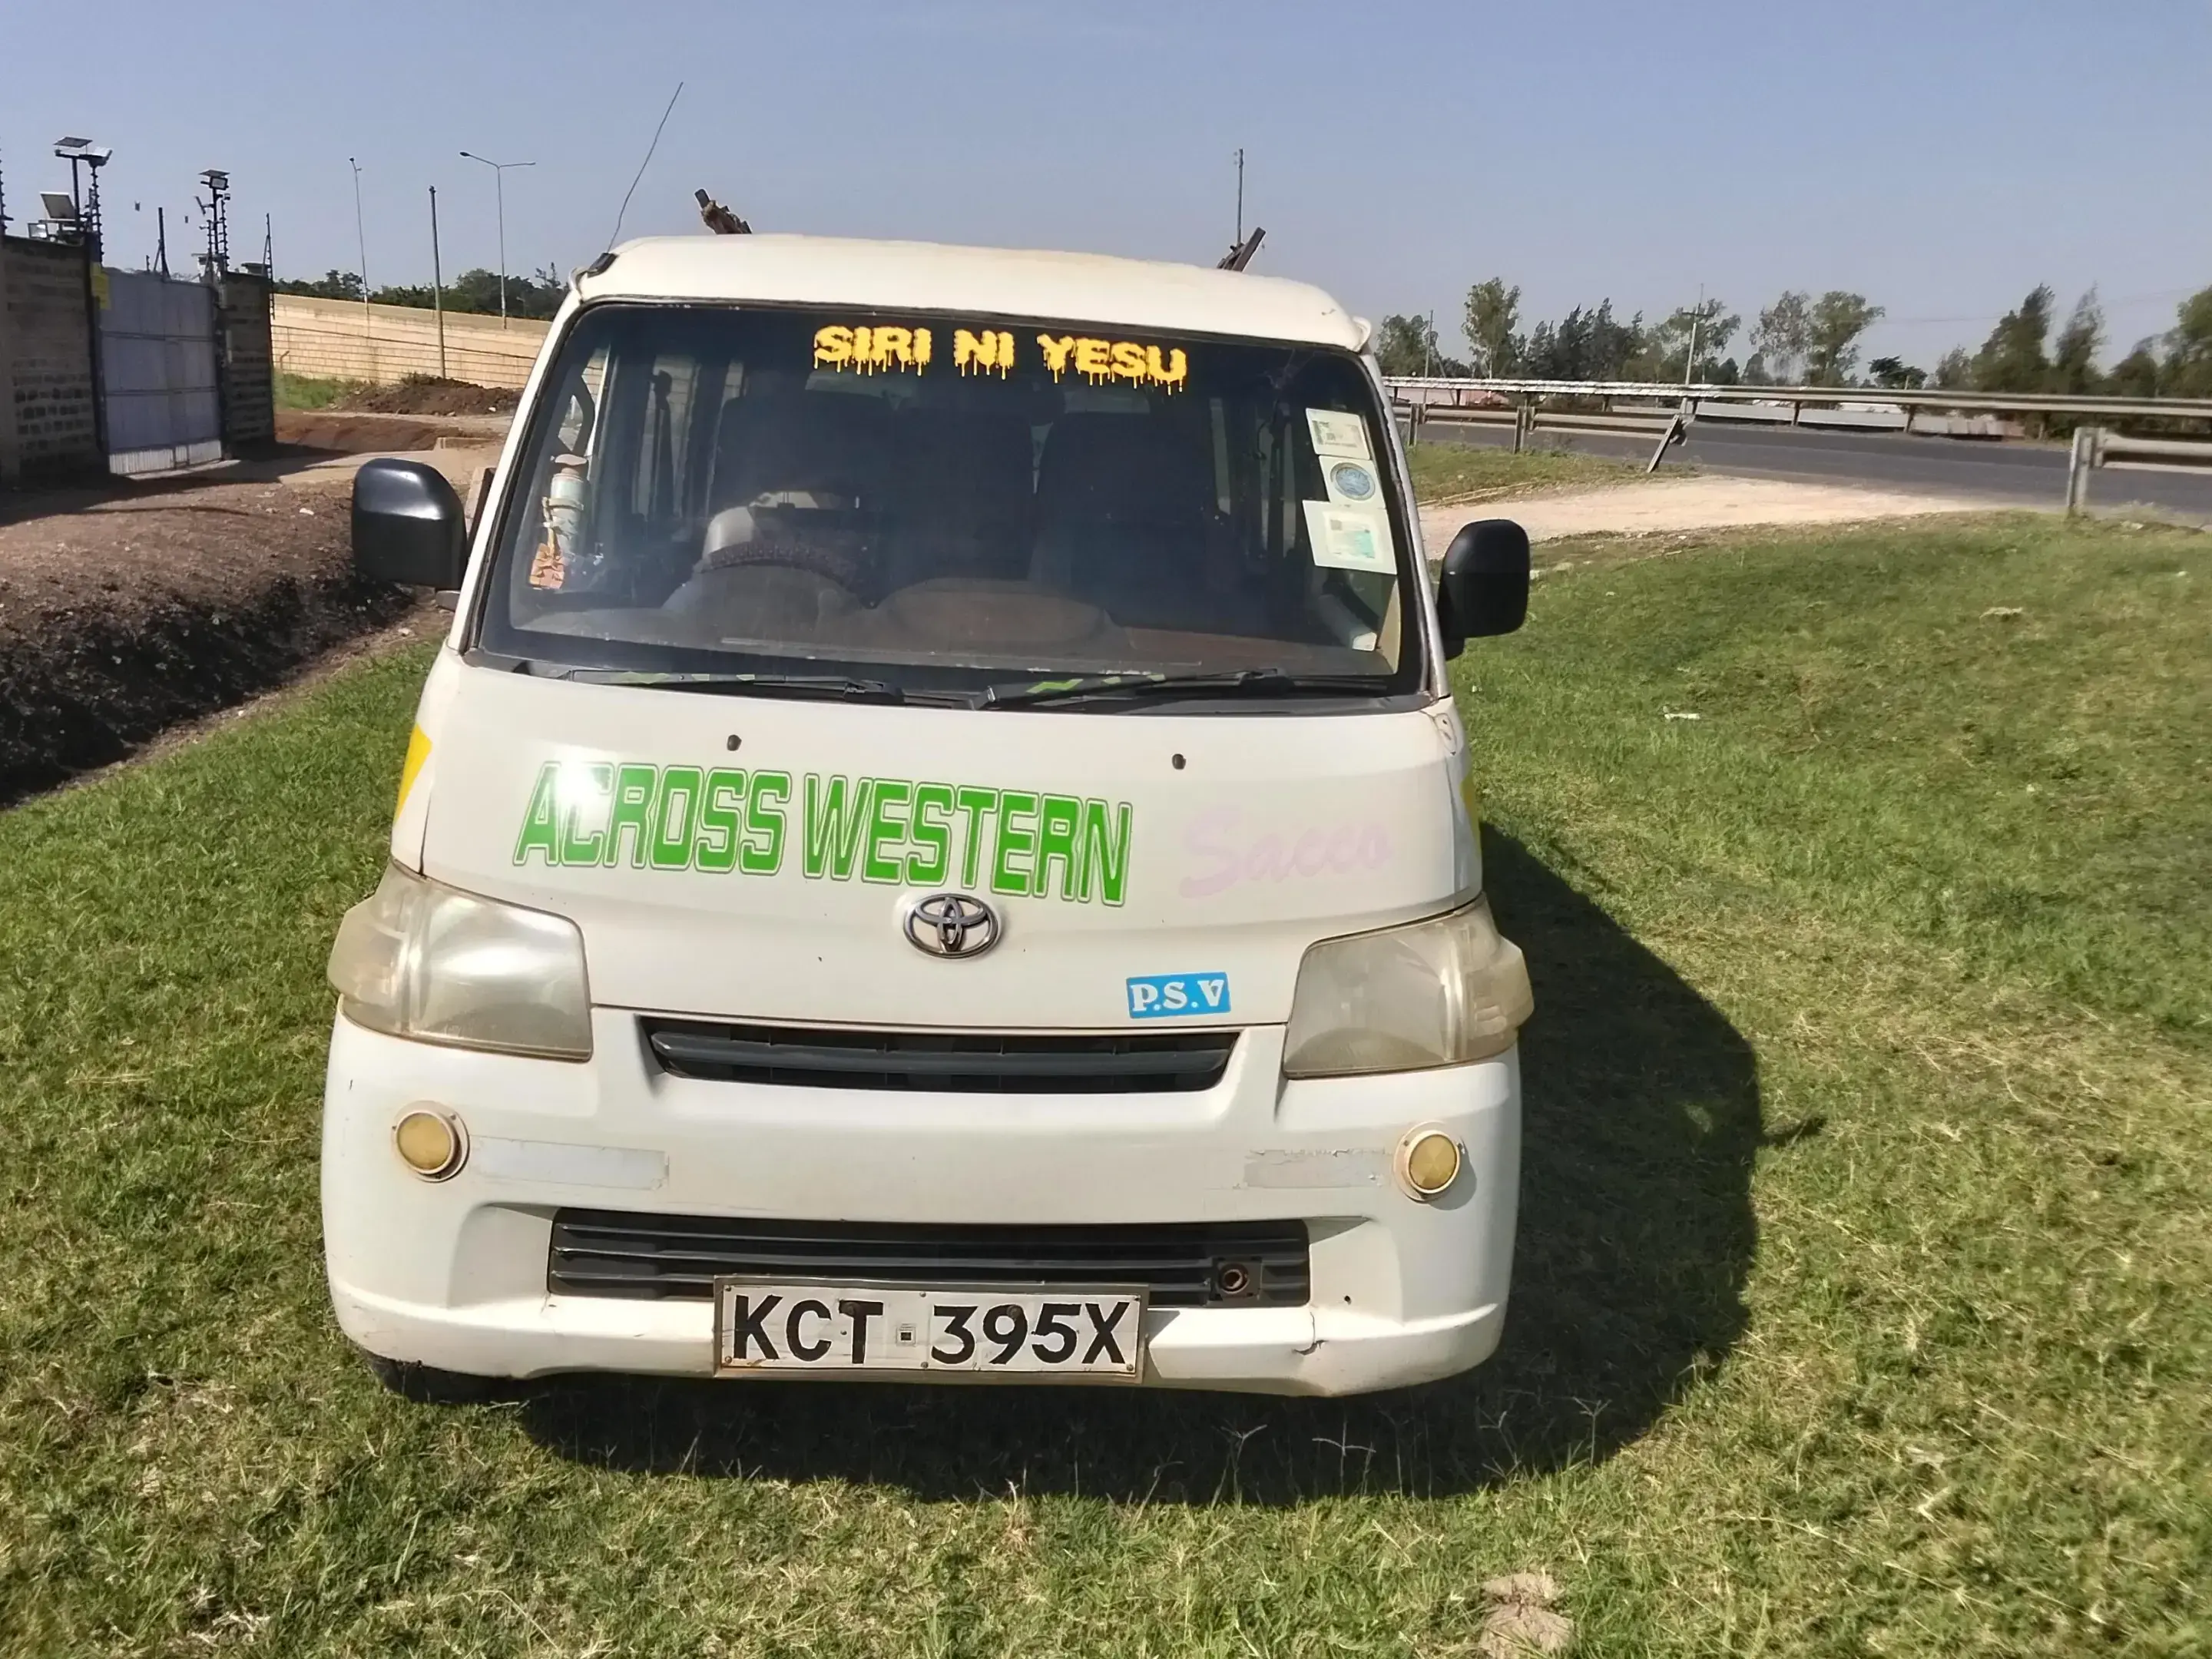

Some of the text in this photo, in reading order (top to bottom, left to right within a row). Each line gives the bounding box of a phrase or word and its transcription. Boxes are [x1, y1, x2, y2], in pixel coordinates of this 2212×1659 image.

[813, 325, 1187, 396] SIRI NI YESU
[513, 761, 792, 876] ACROSS
[803, 773, 1133, 908] WESTERN
[1129, 979, 1224, 1012] P.S.V
[733, 1295, 1130, 1365] KCT 395X
